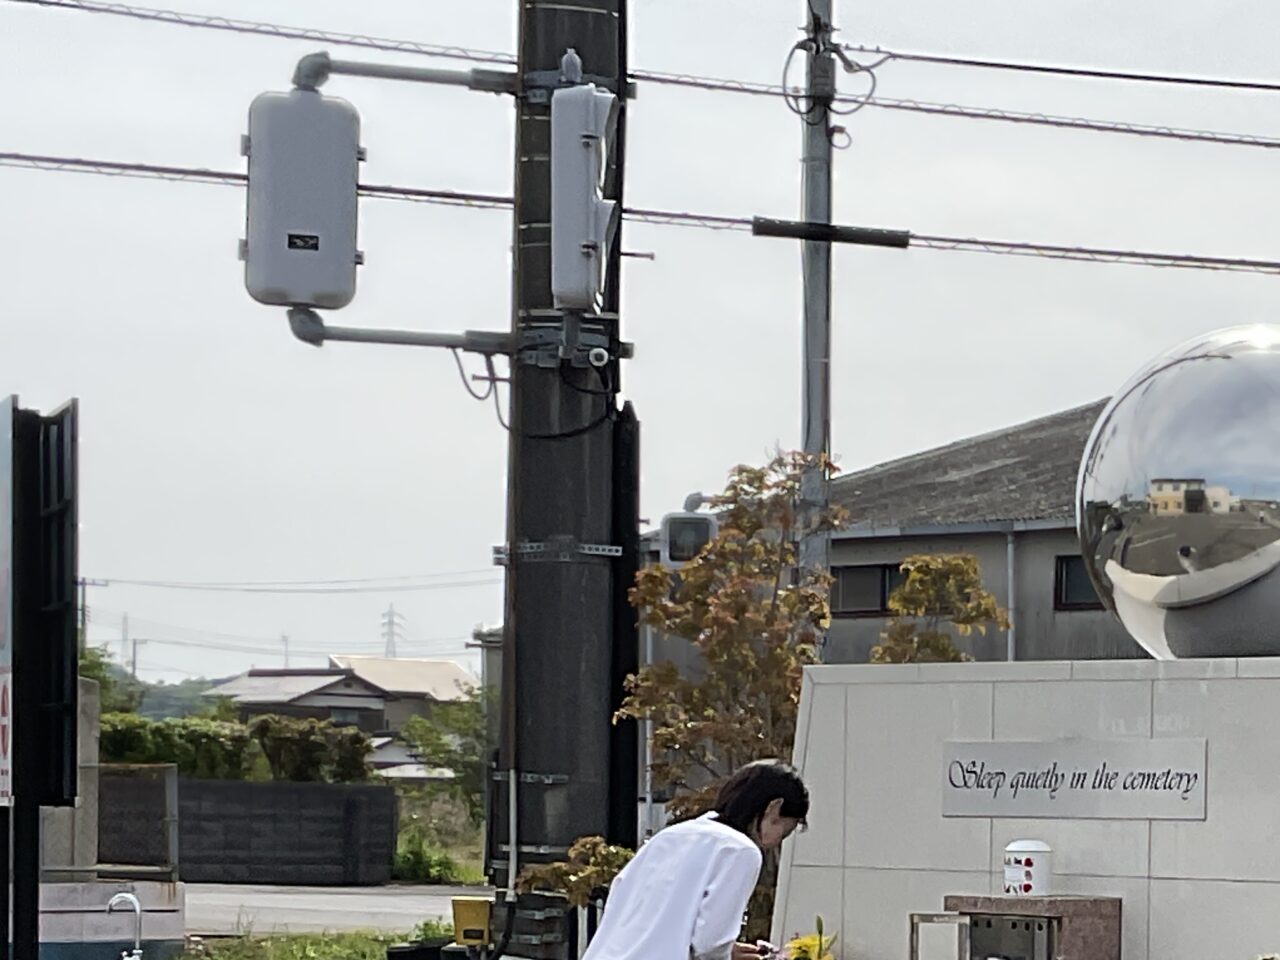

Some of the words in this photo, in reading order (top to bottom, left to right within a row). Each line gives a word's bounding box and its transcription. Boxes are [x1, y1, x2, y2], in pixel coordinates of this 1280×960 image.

[948, 760, 1007, 799] Sleep
[1009, 762, 1066, 799] quietly
[1070, 767, 1088, 790] in
[1091, 762, 1119, 790] the
[1122, 768, 1198, 801] cemetery
